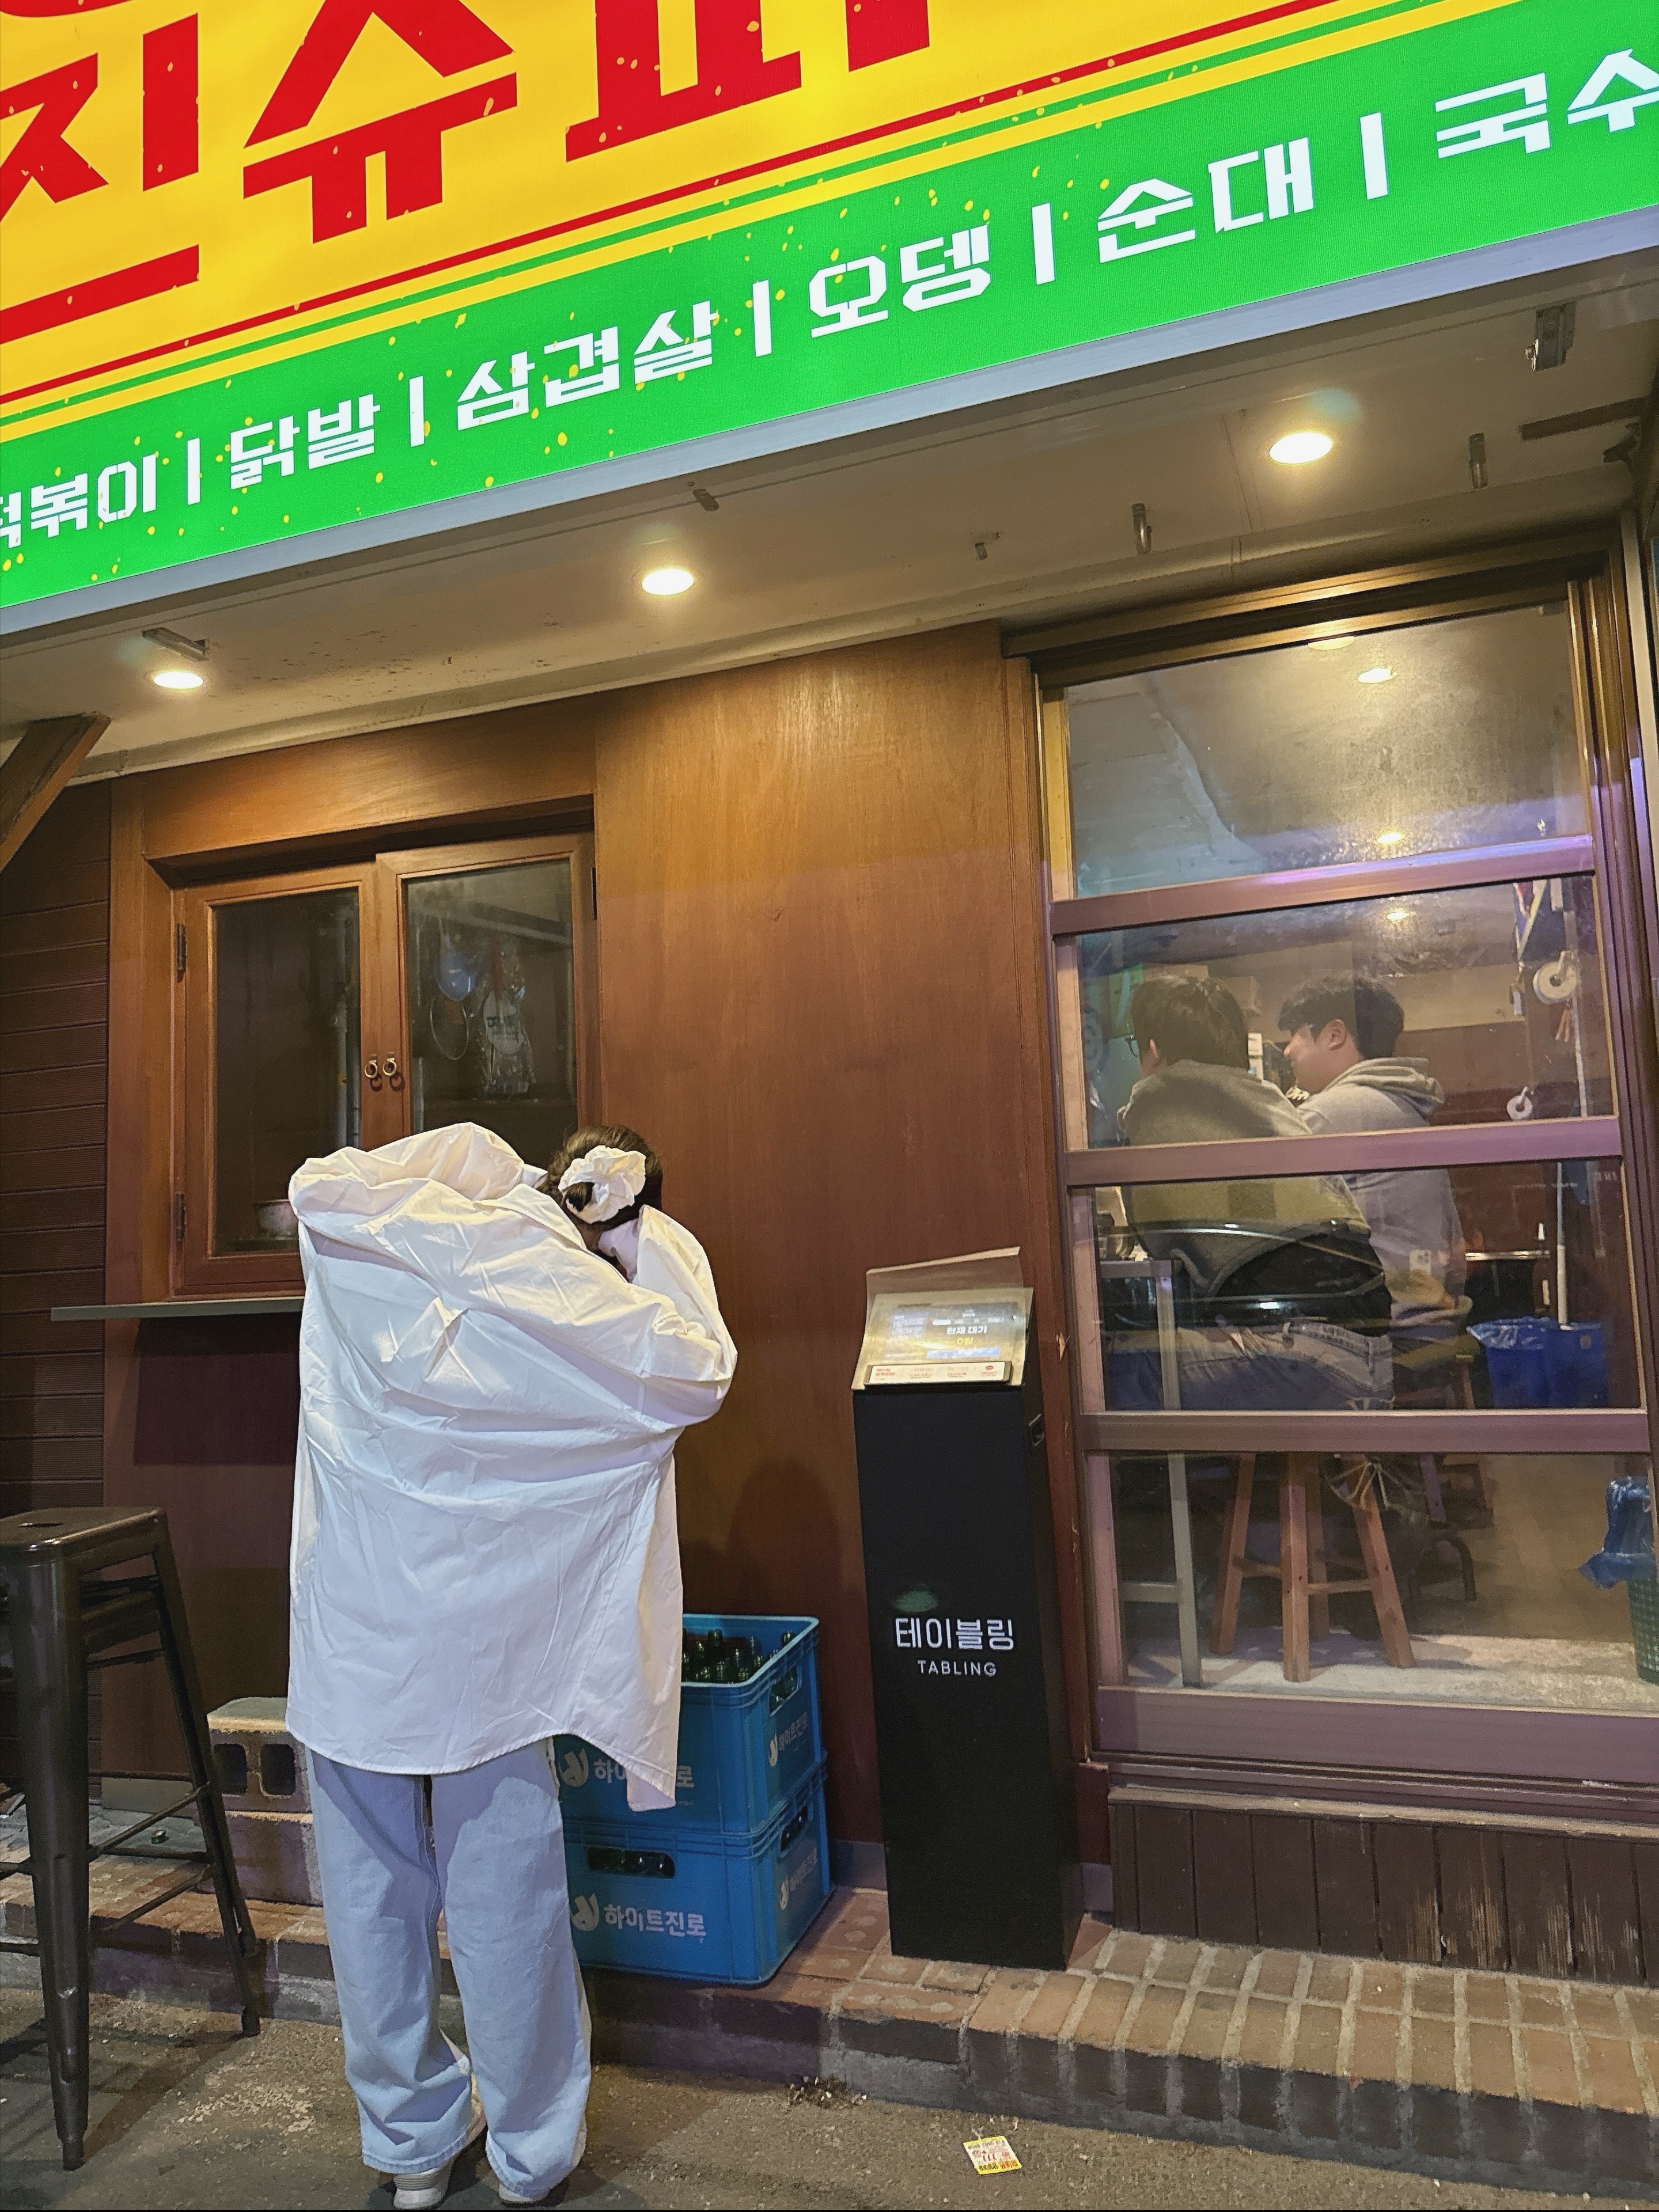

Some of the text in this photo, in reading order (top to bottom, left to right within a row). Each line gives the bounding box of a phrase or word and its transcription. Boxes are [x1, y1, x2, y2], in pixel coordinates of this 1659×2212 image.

[230, 393, 381, 490] 닭발
[457, 301, 718, 431] 삼겹살
[808, 224, 991, 338] 오뎅
[1097, 136, 1315, 263] 순대
[1435, 48, 1659, 158] 국수
[968, 1325, 987, 1334] 대기
[895, 1617, 1014, 1651] 테이블링
[917, 1660, 997, 1677] TABLING
[604, 1903, 707, 1937] 하이트진로
